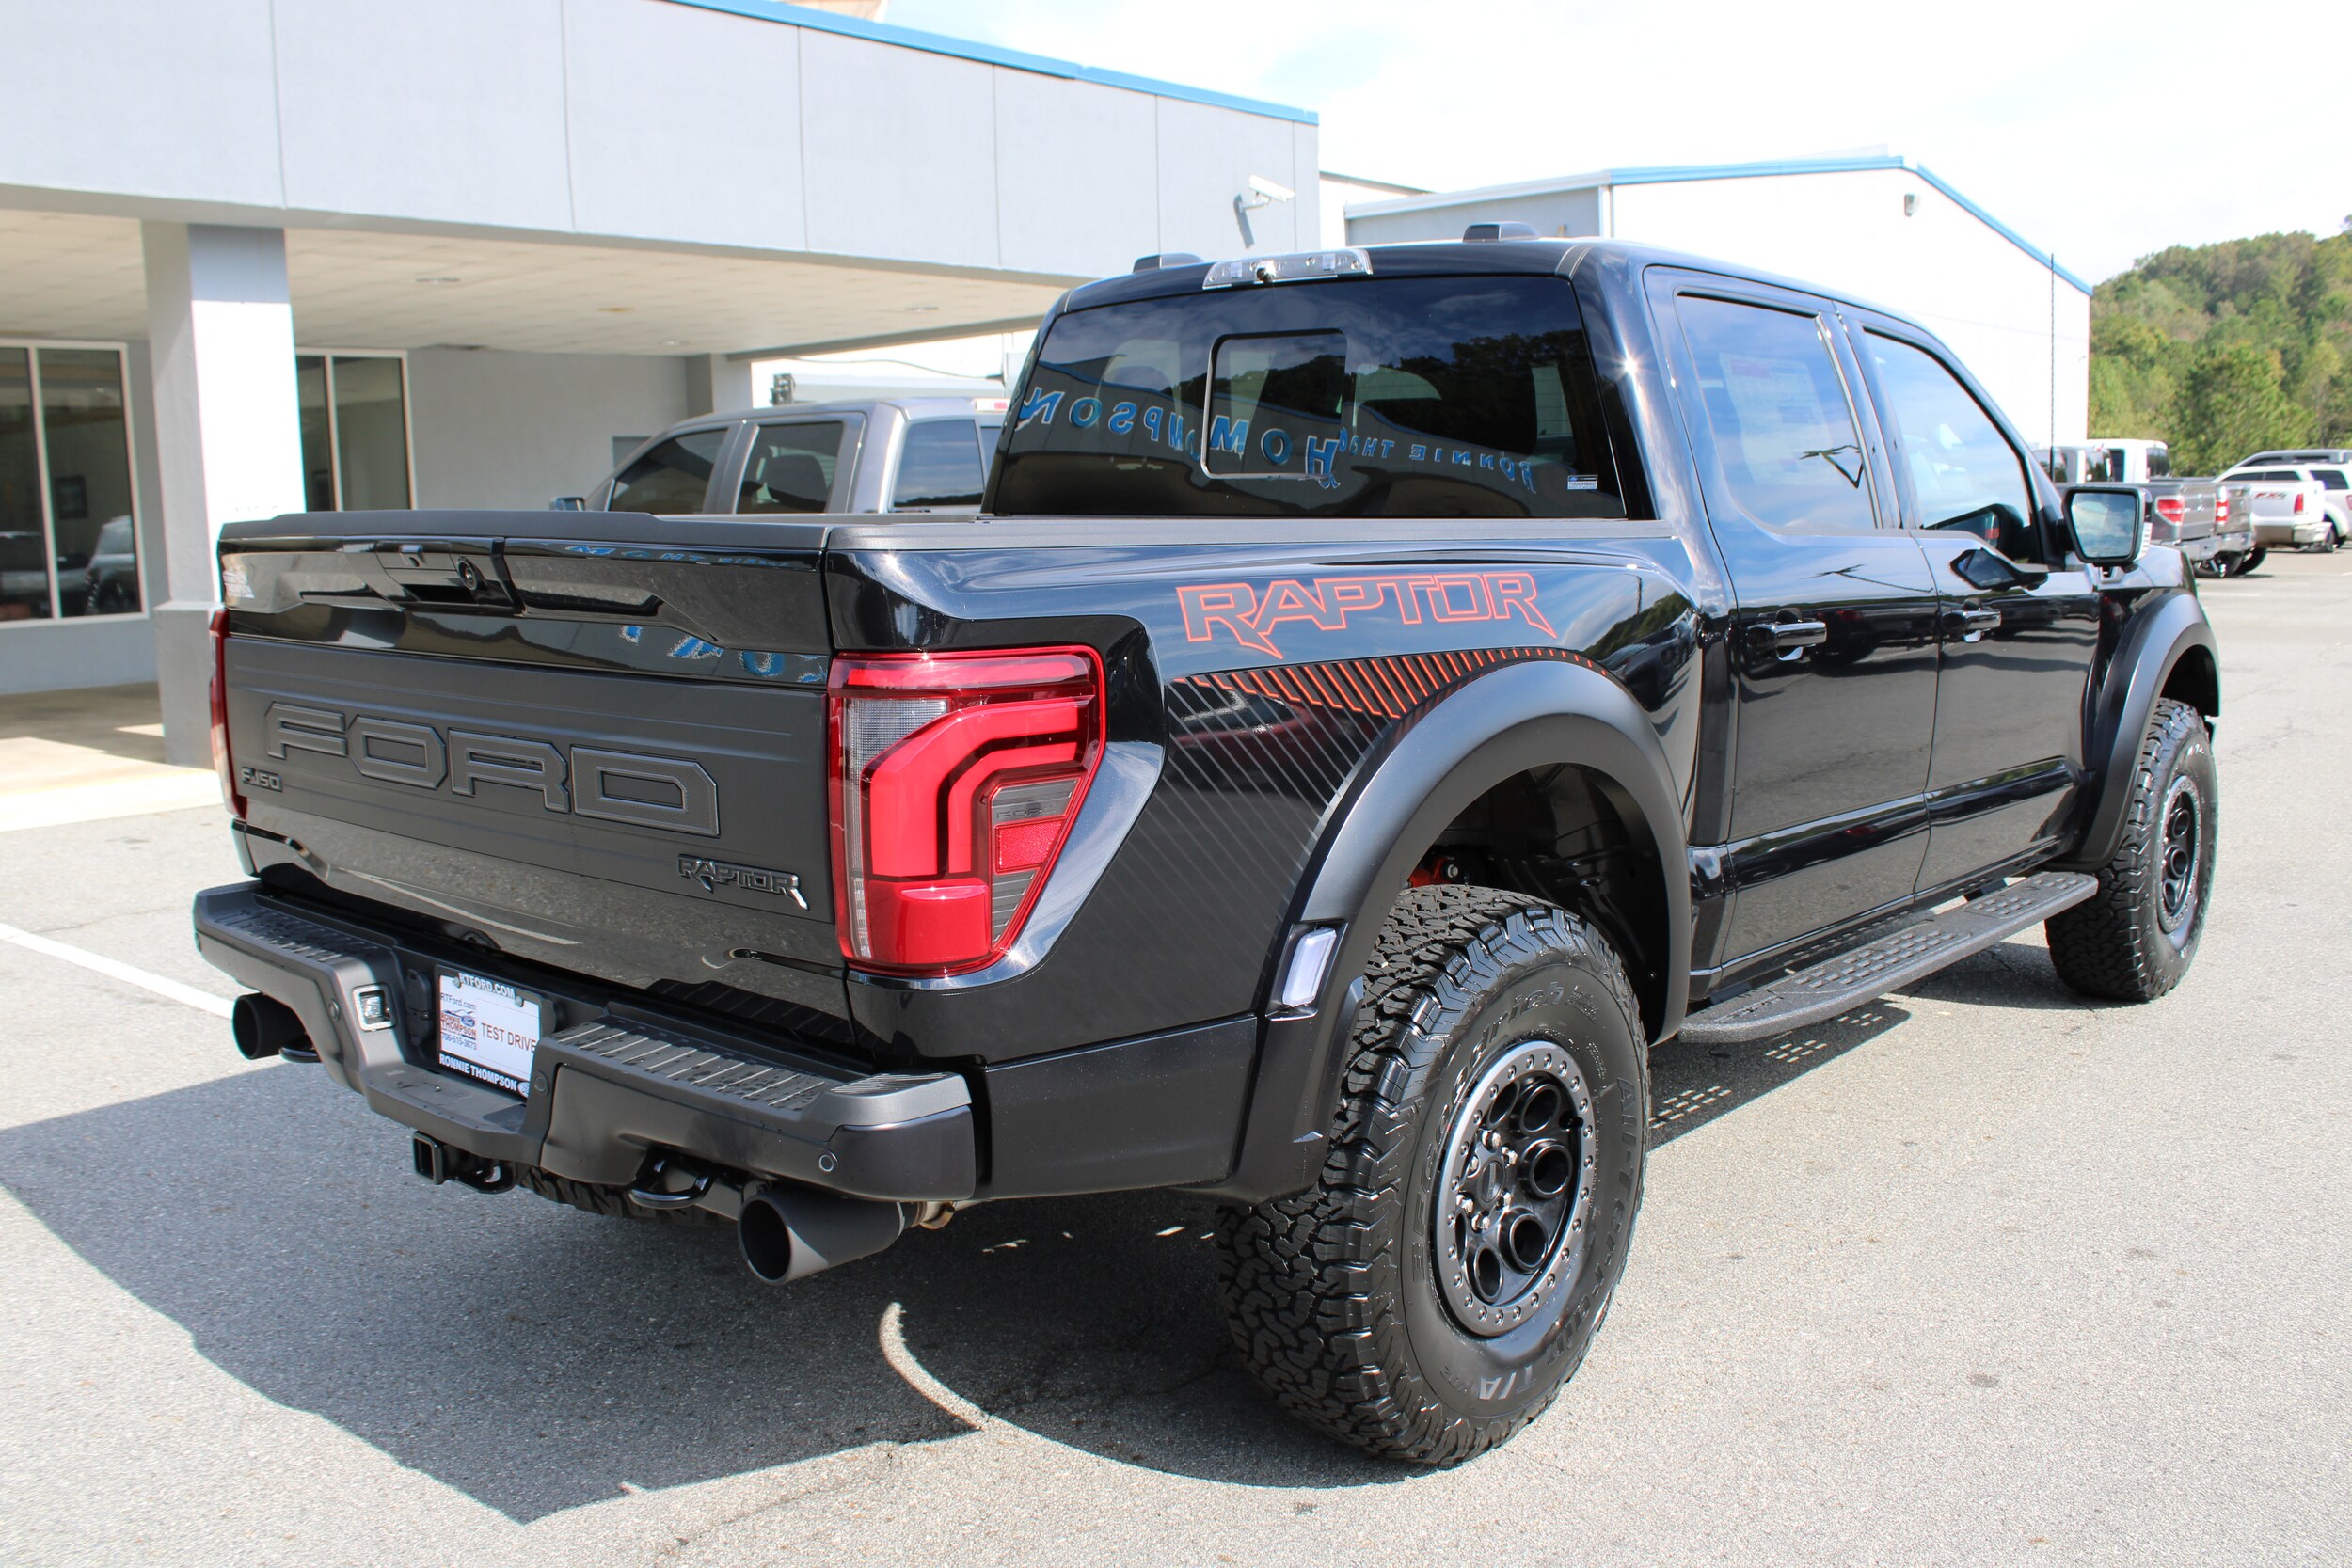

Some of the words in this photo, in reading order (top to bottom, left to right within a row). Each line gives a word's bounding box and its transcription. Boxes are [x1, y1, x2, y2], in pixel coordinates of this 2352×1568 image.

[1176, 572, 1557, 659] RAPTOR
[265, 701, 720, 837] FORD
[677, 853, 810, 911] RAPTOR
[440, 992, 476, 1010] RTFord.com
[458, 972, 516, 999] RTFORD.COM
[442, 1020, 477, 1037] THOMPSON
[481, 1022, 504, 1045] TEST
[507, 1035, 536, 1053] DRIVE
[439, 1053, 470, 1074] RONNIE
[470, 1064, 517, 1092] THOMPSON
